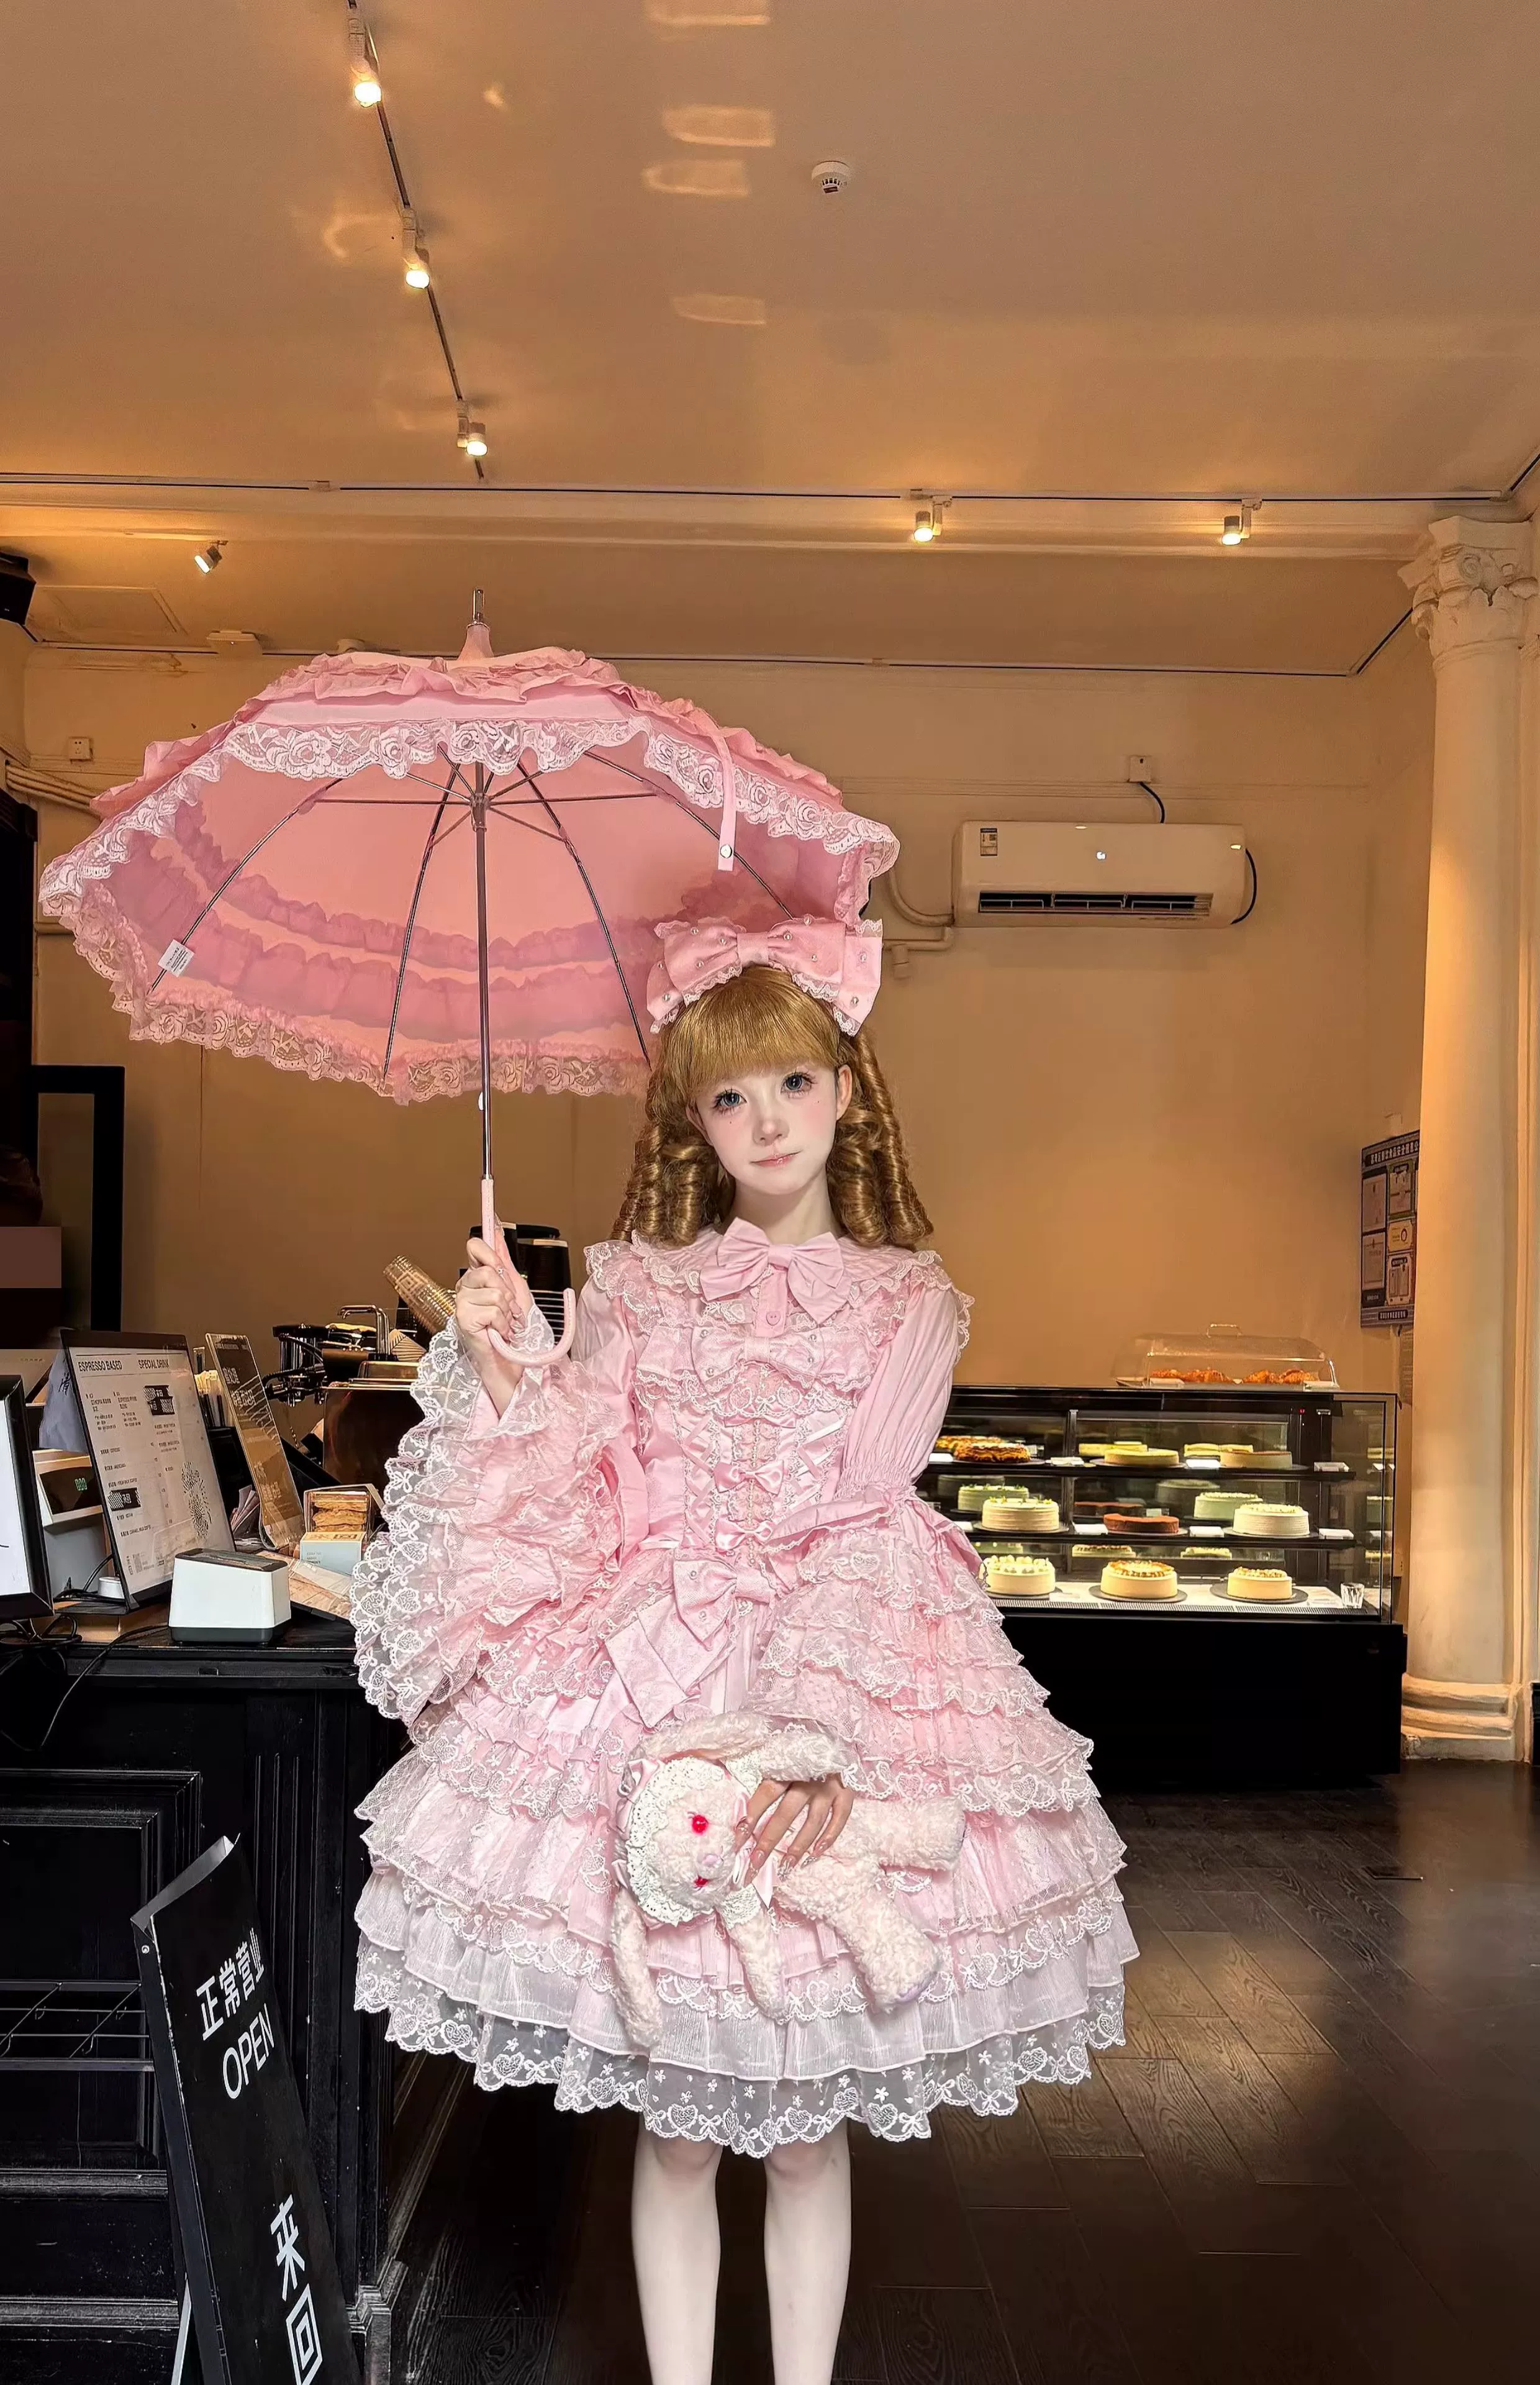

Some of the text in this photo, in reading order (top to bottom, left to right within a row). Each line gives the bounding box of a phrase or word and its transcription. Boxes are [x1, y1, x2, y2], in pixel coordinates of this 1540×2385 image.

[78, 1360, 122, 1372] ESPRESSO BASED
[138, 1359, 157, 1369] SPECIAL
[196, 1927, 265, 2041] 正常营业
[222, 2002, 274, 2099] OPEN
[270, 2194, 323, 2385] 来回
